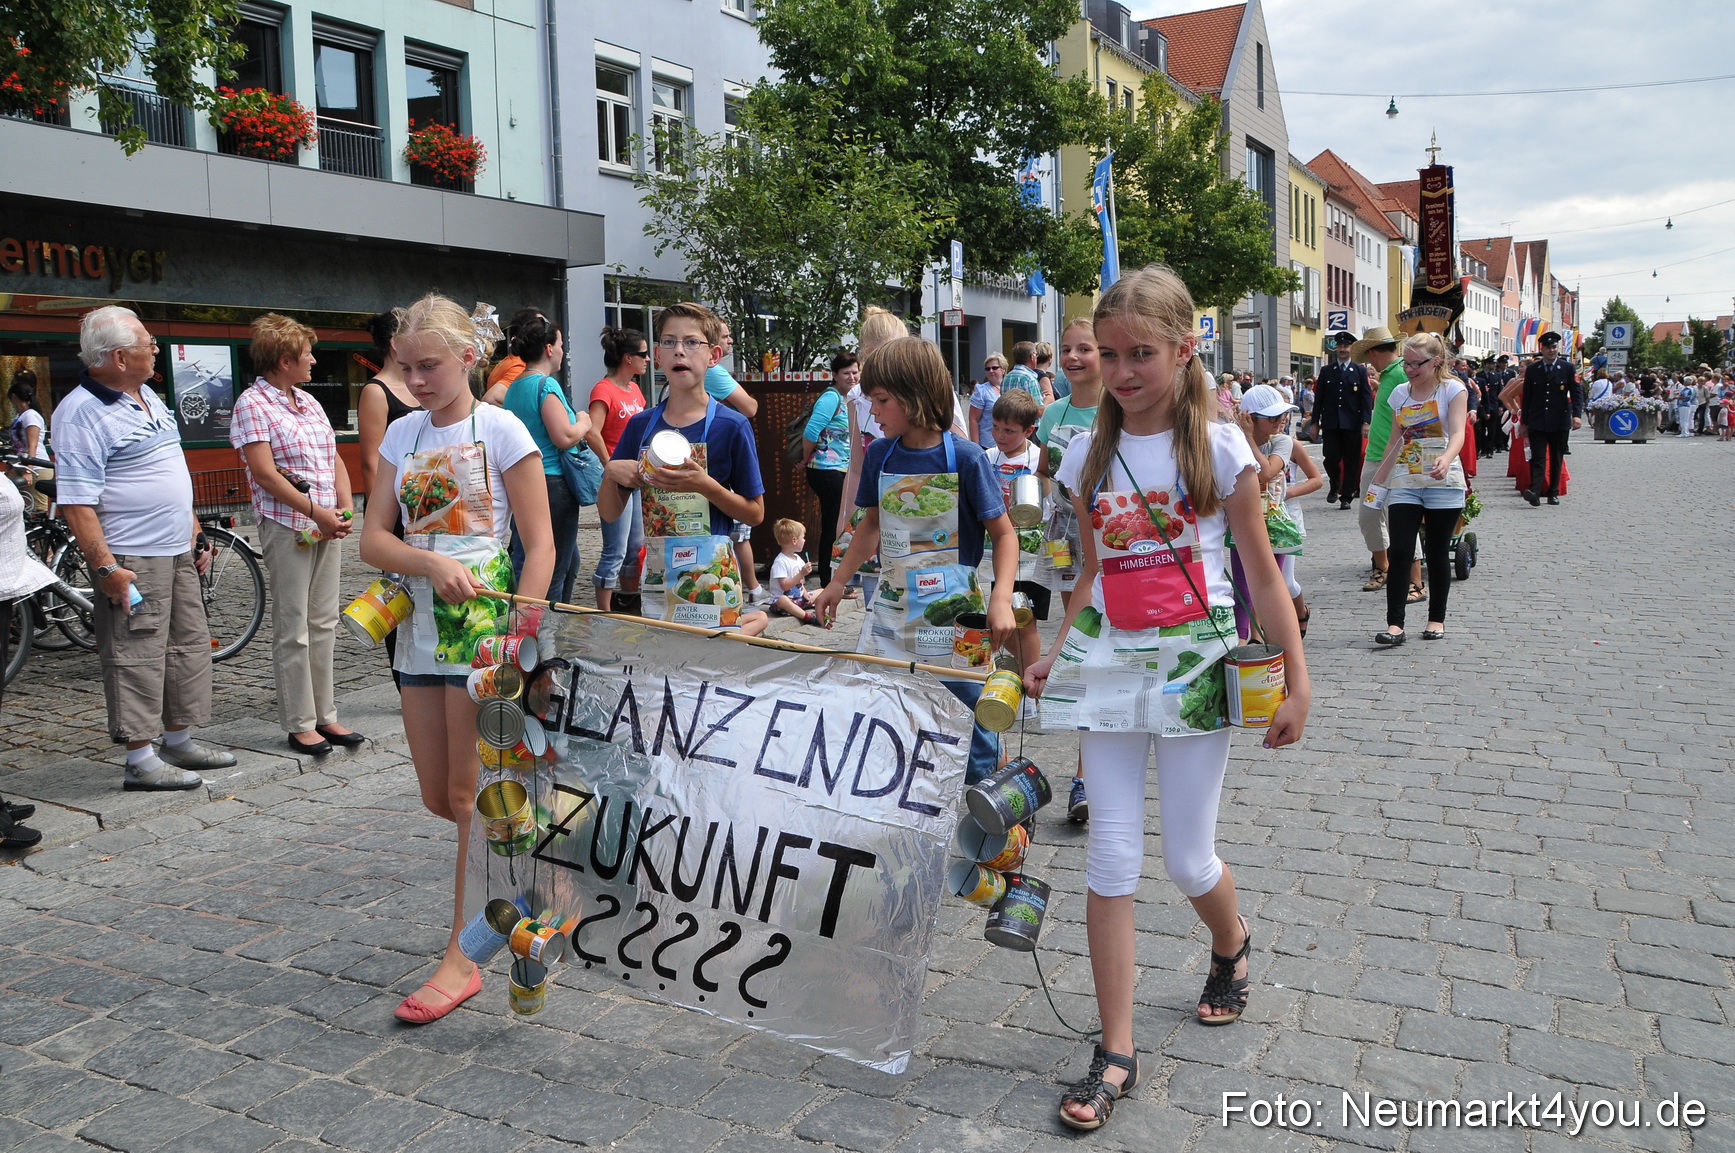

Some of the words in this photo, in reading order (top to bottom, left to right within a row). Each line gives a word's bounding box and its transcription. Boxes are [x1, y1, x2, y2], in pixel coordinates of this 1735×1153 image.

[0, 237, 167, 293] ermayer
[1119, 553, 1175, 570] HIMBEEREN
[531, 783, 876, 939] ZUKUNFT
